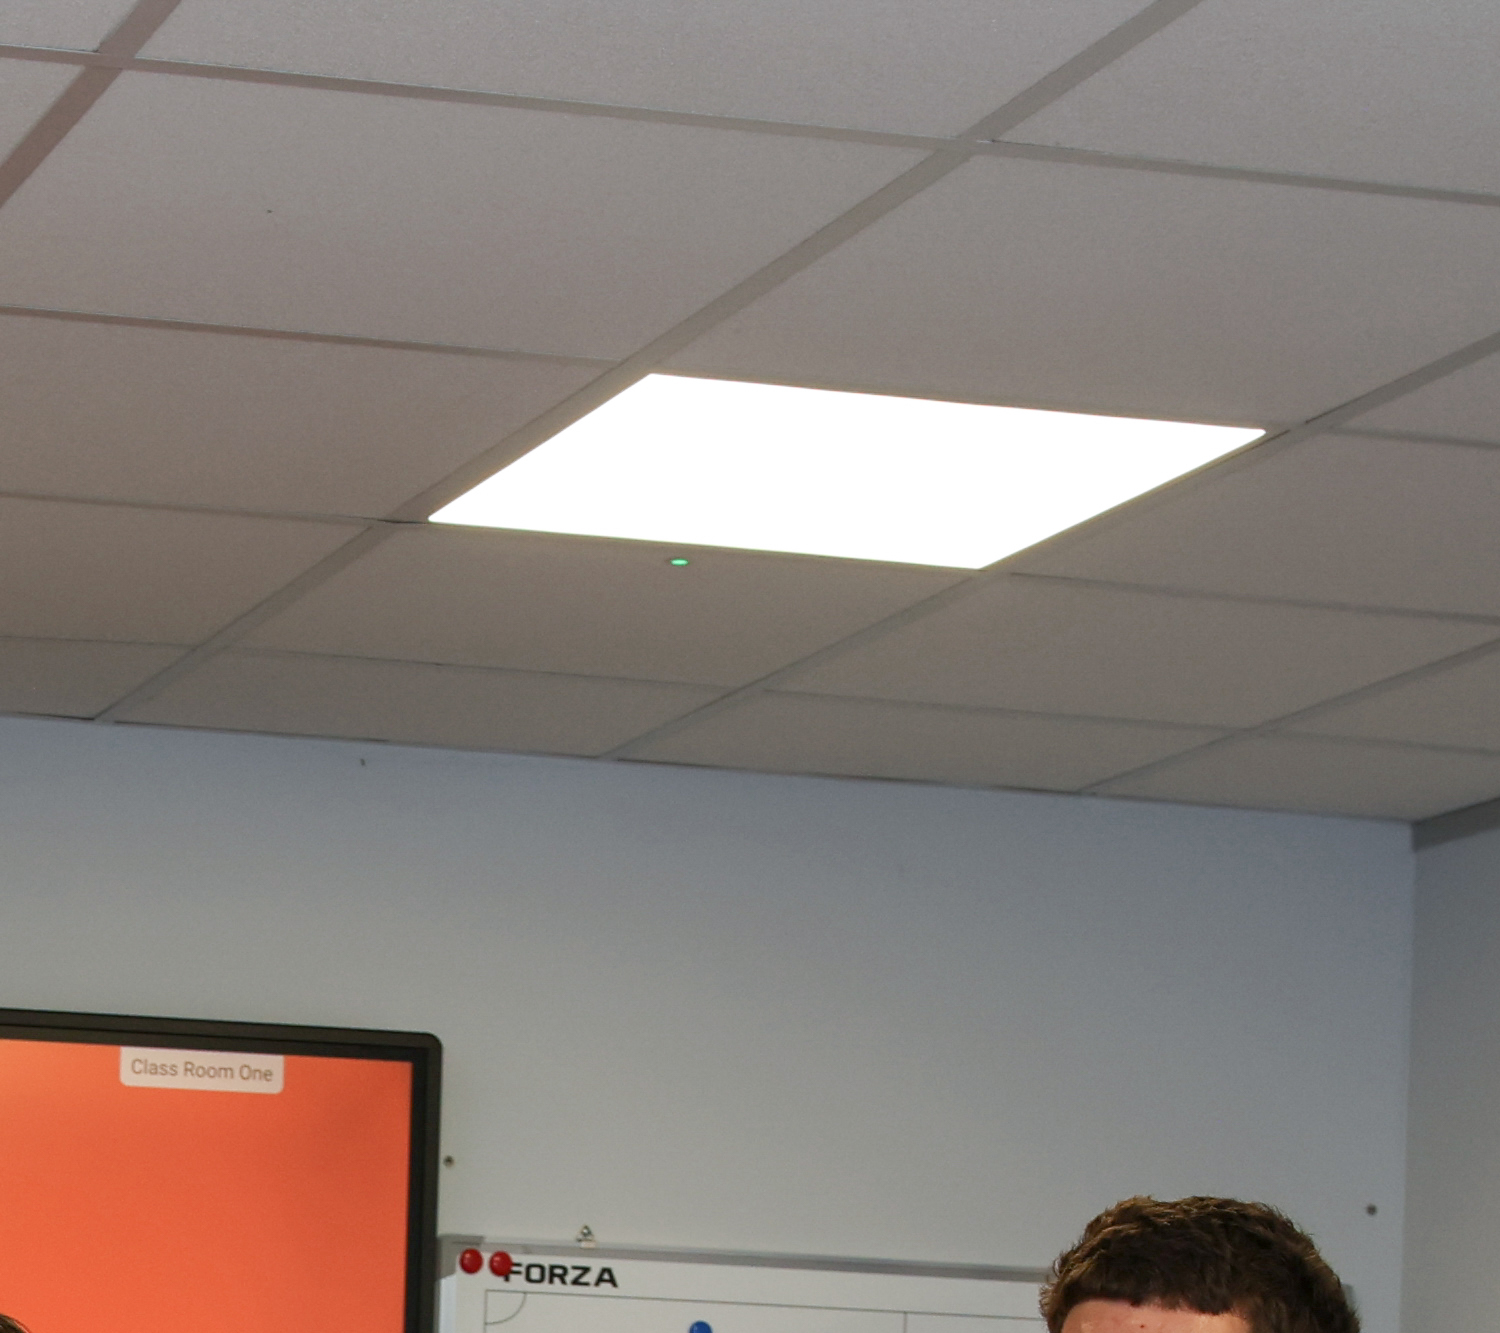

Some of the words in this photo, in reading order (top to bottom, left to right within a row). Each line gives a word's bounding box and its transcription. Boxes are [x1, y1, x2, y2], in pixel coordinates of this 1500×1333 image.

[131, 1057, 178, 1078] Class
[183, 1061, 234, 1081] Room
[239, 1063, 273, 1083] One
[502, 1261, 619, 1289] FORZA
